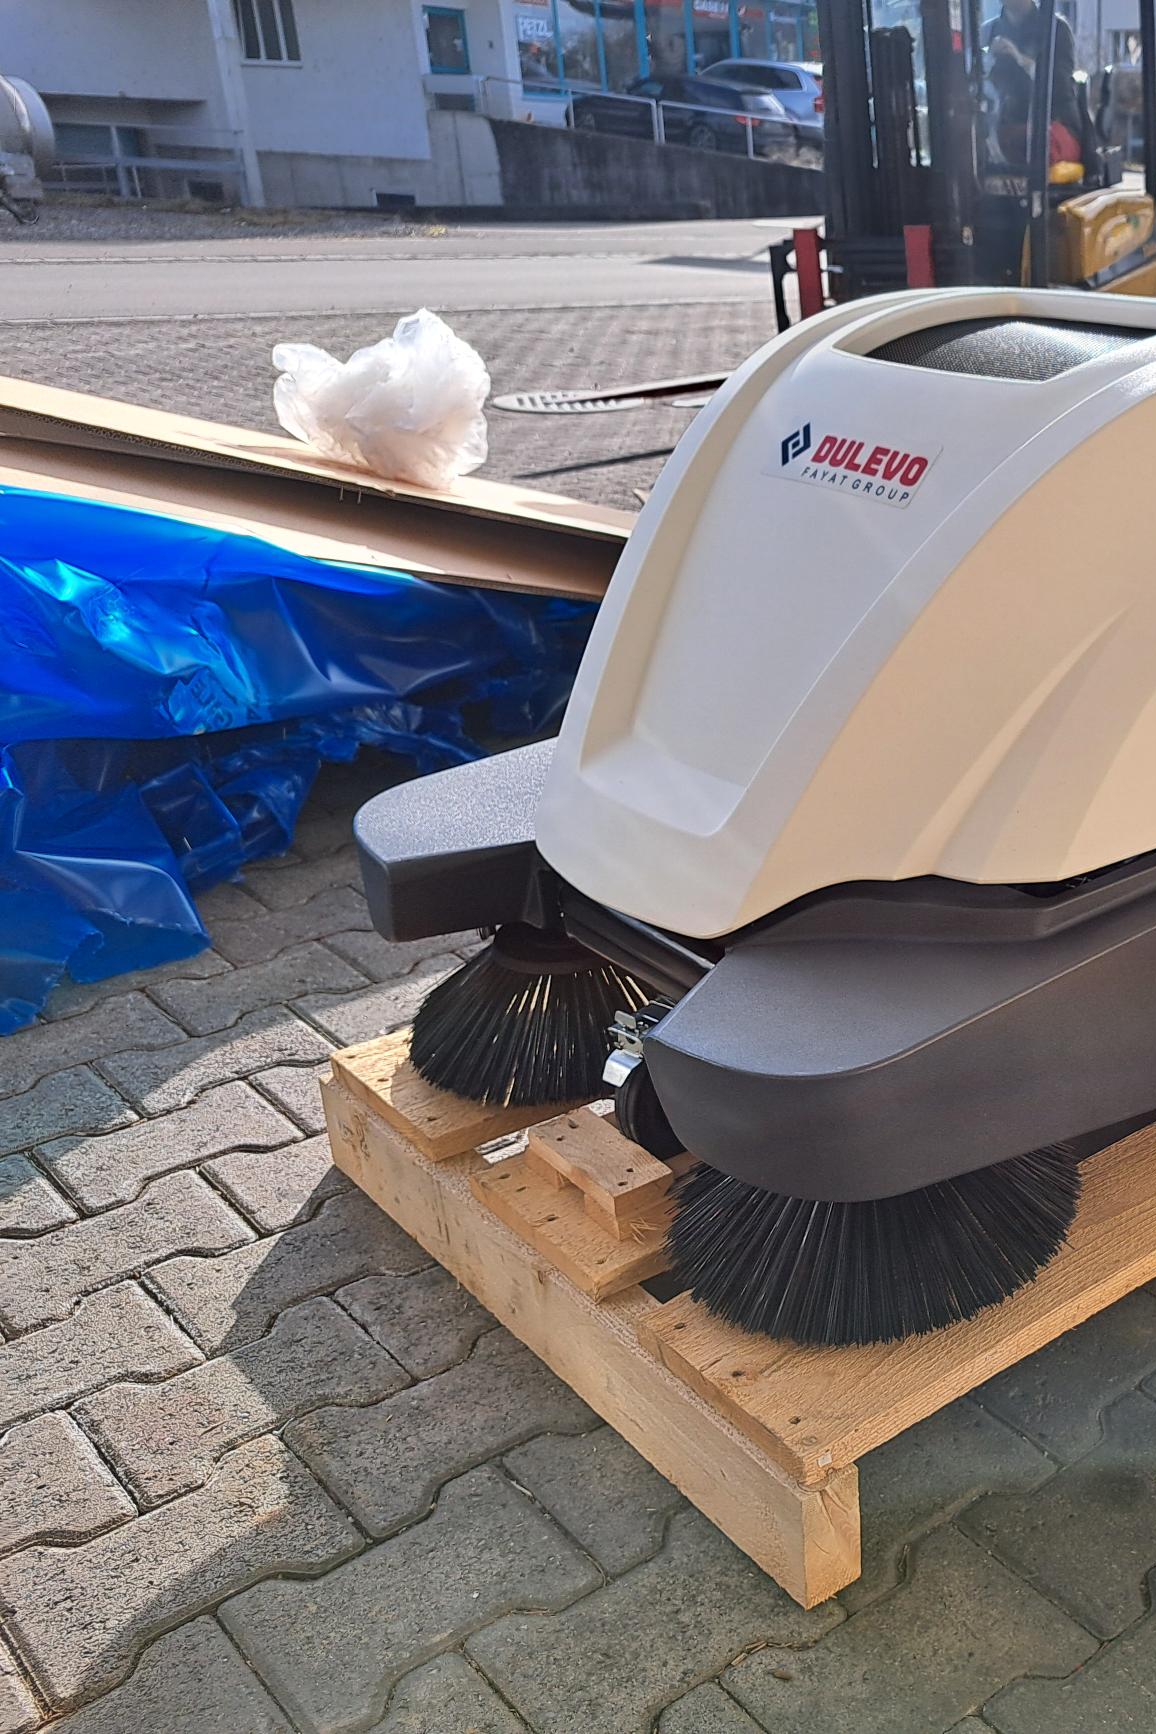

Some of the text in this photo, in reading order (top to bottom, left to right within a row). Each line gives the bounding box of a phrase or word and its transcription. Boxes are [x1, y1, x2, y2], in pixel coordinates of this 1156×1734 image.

[811, 435, 929, 487] DULEVO
[801, 466, 910, 503] FAYAT GROUP
